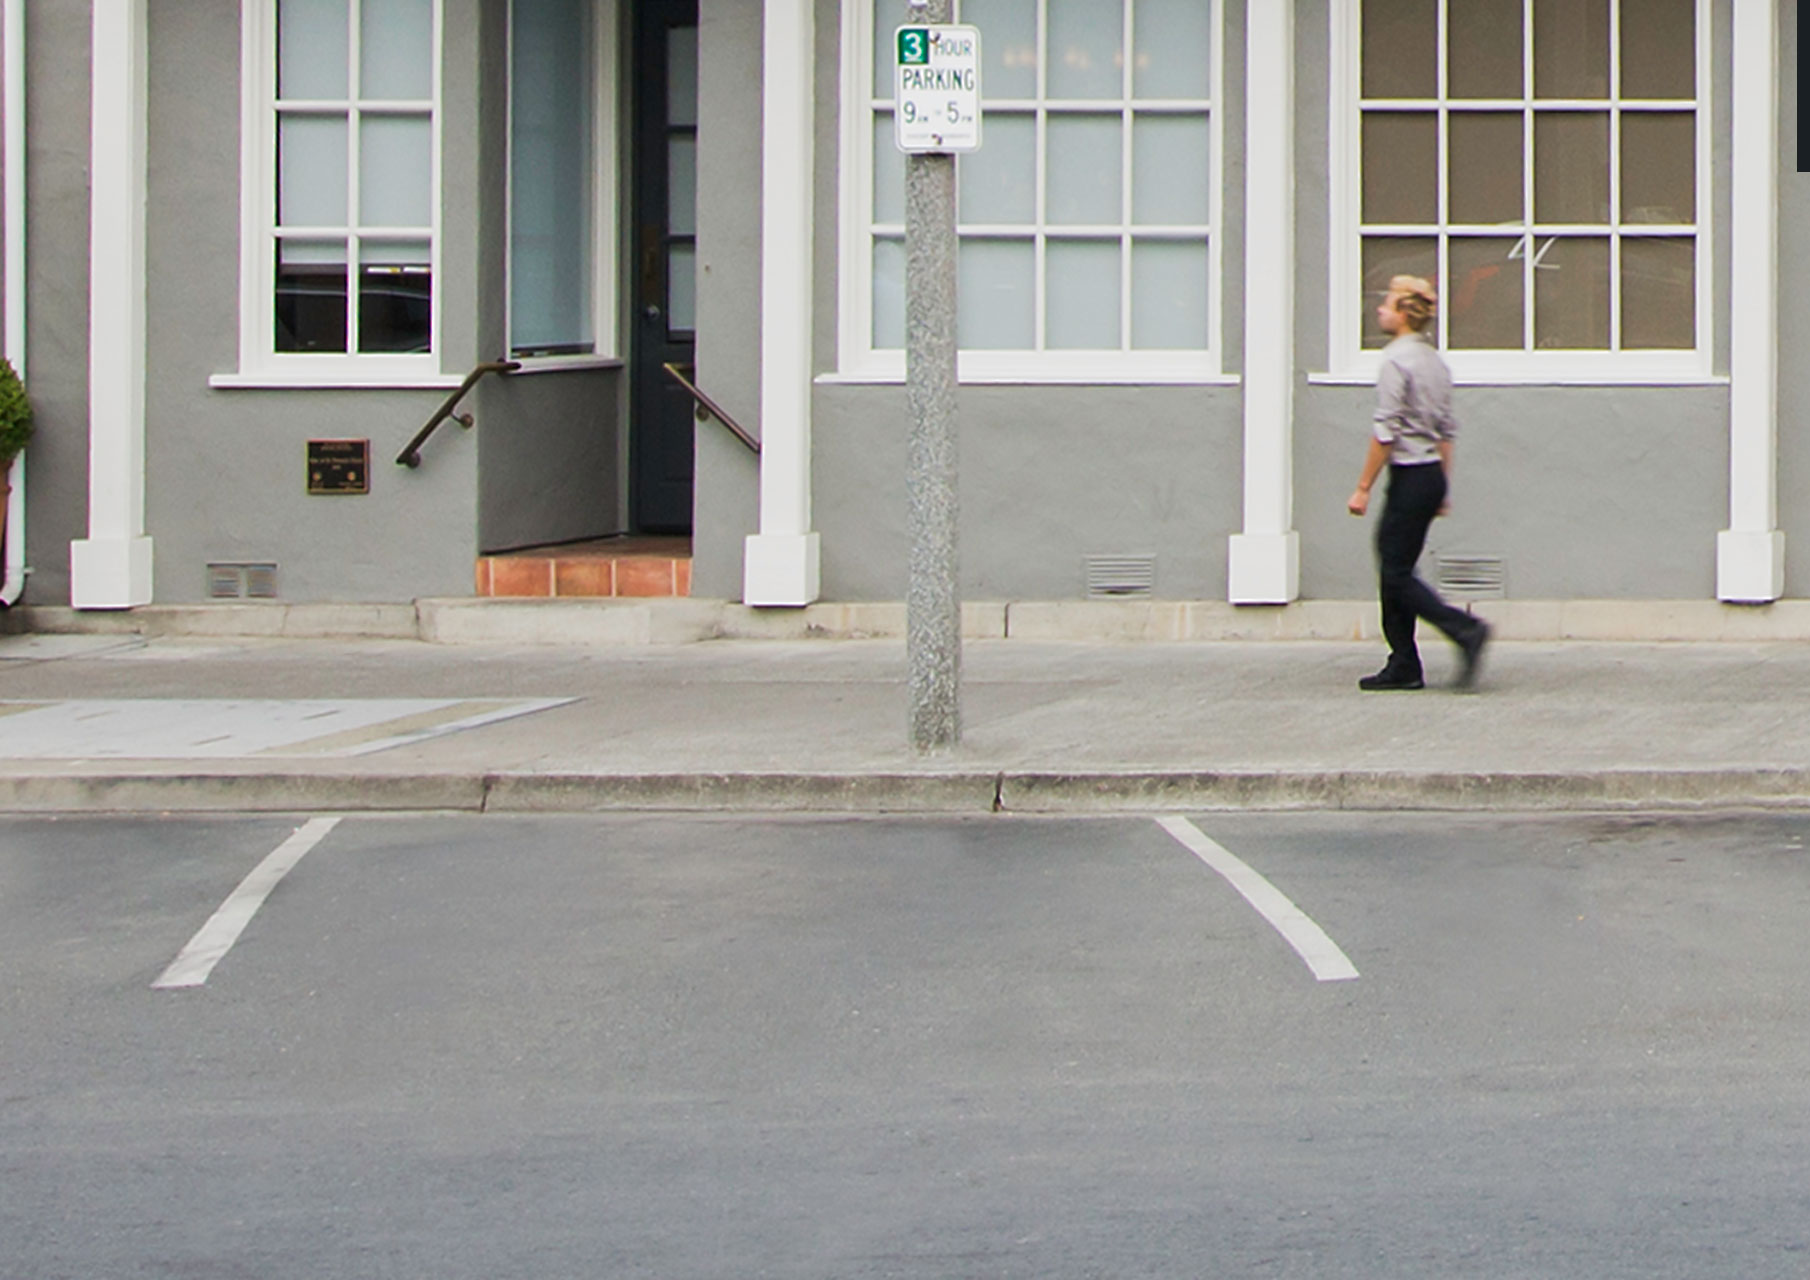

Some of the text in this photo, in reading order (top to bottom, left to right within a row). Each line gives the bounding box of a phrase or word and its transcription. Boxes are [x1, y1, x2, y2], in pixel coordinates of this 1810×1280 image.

[904, 33, 972, 58] 3 HOUR
[903, 68, 975, 91] PARKING
[903, 100, 916, 124] 9
[947, 100, 960, 124] 5
